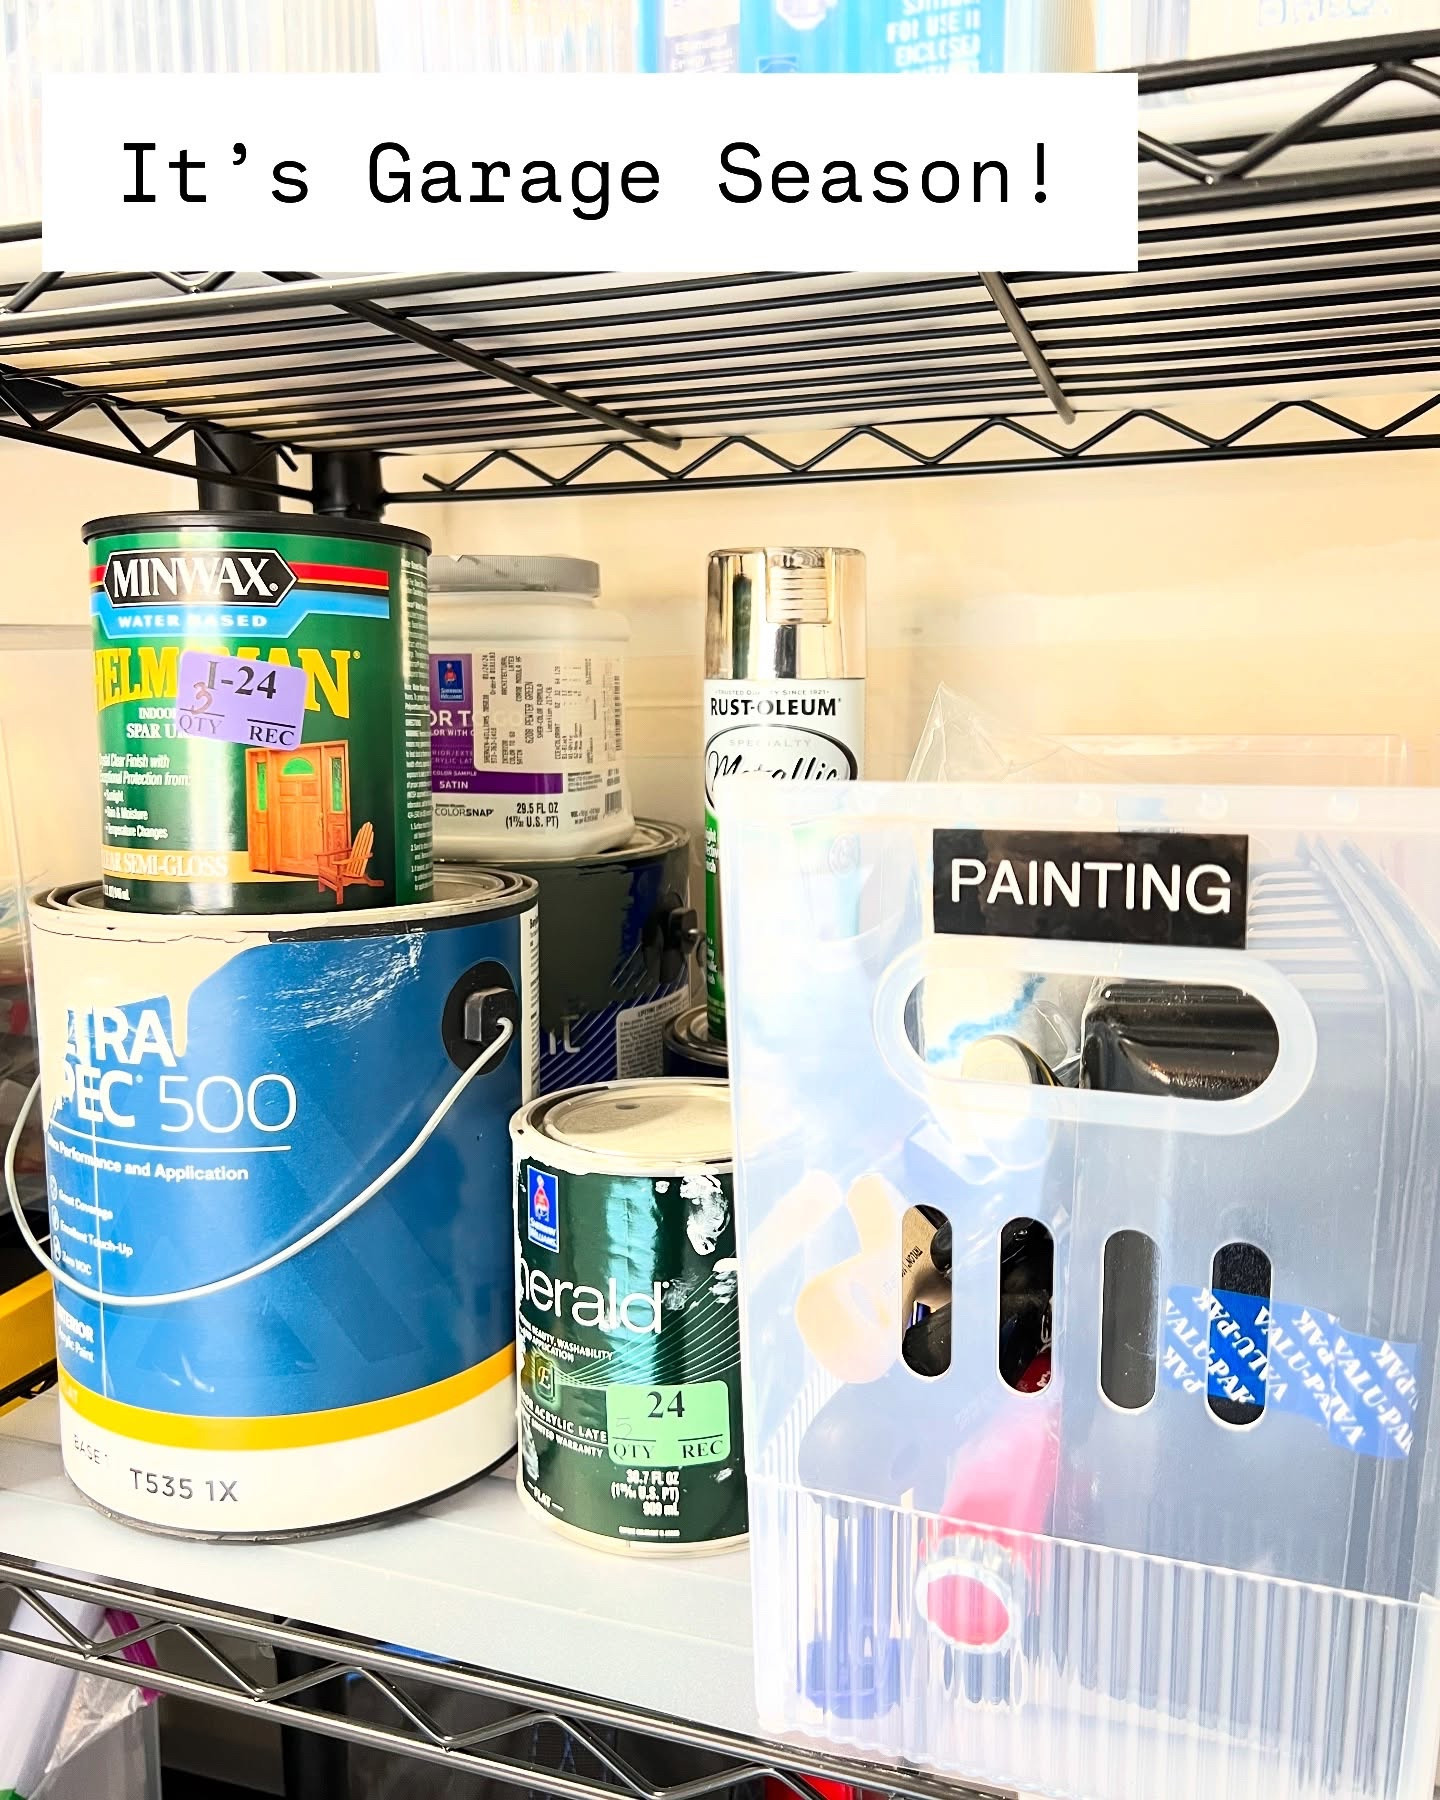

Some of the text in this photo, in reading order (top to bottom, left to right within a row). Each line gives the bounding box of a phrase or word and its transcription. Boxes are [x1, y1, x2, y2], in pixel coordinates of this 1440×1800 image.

[118, 613, 267, 629] WATER BASED
[525, 682, 533, 700] GREEN
[138, 707, 176, 719] INDOO
[525, 704, 533, 726] PEWTER
[711, 697, 837, 716] RUST-OLEUM
[126, 723, 161, 738] SPAR
[179, 714, 223, 735] QTY
[249, 725, 295, 746] REC
[447, 729, 468, 737] WITH
[125, 753, 149, 768] Finish
[150, 754, 170, 768] with
[123, 770, 163, 786] Protection
[454, 769, 478, 777] SAMPLE
[439, 780, 469, 790] SATIN
[434, 807, 493, 817] COLORSNAP
[516, 802, 559, 814] 29.5 FL OZ
[526, 816, 544, 828] U.S.
[546, 815, 559, 829] PT)
[123, 853, 229, 877] SEMI-GLOSS
[950, 857, 1232, 916] PAINTING
[159, 1073, 297, 1134] 500
[60, 1141, 121, 1173] Performance
[124, 1162, 151, 1177] and
[154, 1163, 249, 1182] Application
[556, 1337, 614, 1361] WASHABILITY
[1164, 1297, 1256, 1404] VALU-PAK
[1192, 1287, 1288, 1403] VALU-PAK
[646, 1390, 686, 1418] 24
[534, 1404, 575, 1434] ACRYLIC
[578, 1425, 608, 1443] LATE
[556, 1433, 604, 1459] WARRANTY
[613, 1440, 724, 1461] QTY REC
[129, 1467, 239, 1502] T535 1X
[651, 1470, 664, 1486] FL
[665, 1471, 680, 1486] OZ
[637, 1485, 660, 1501] U.S.
[661, 1486, 680, 1503] PT)
